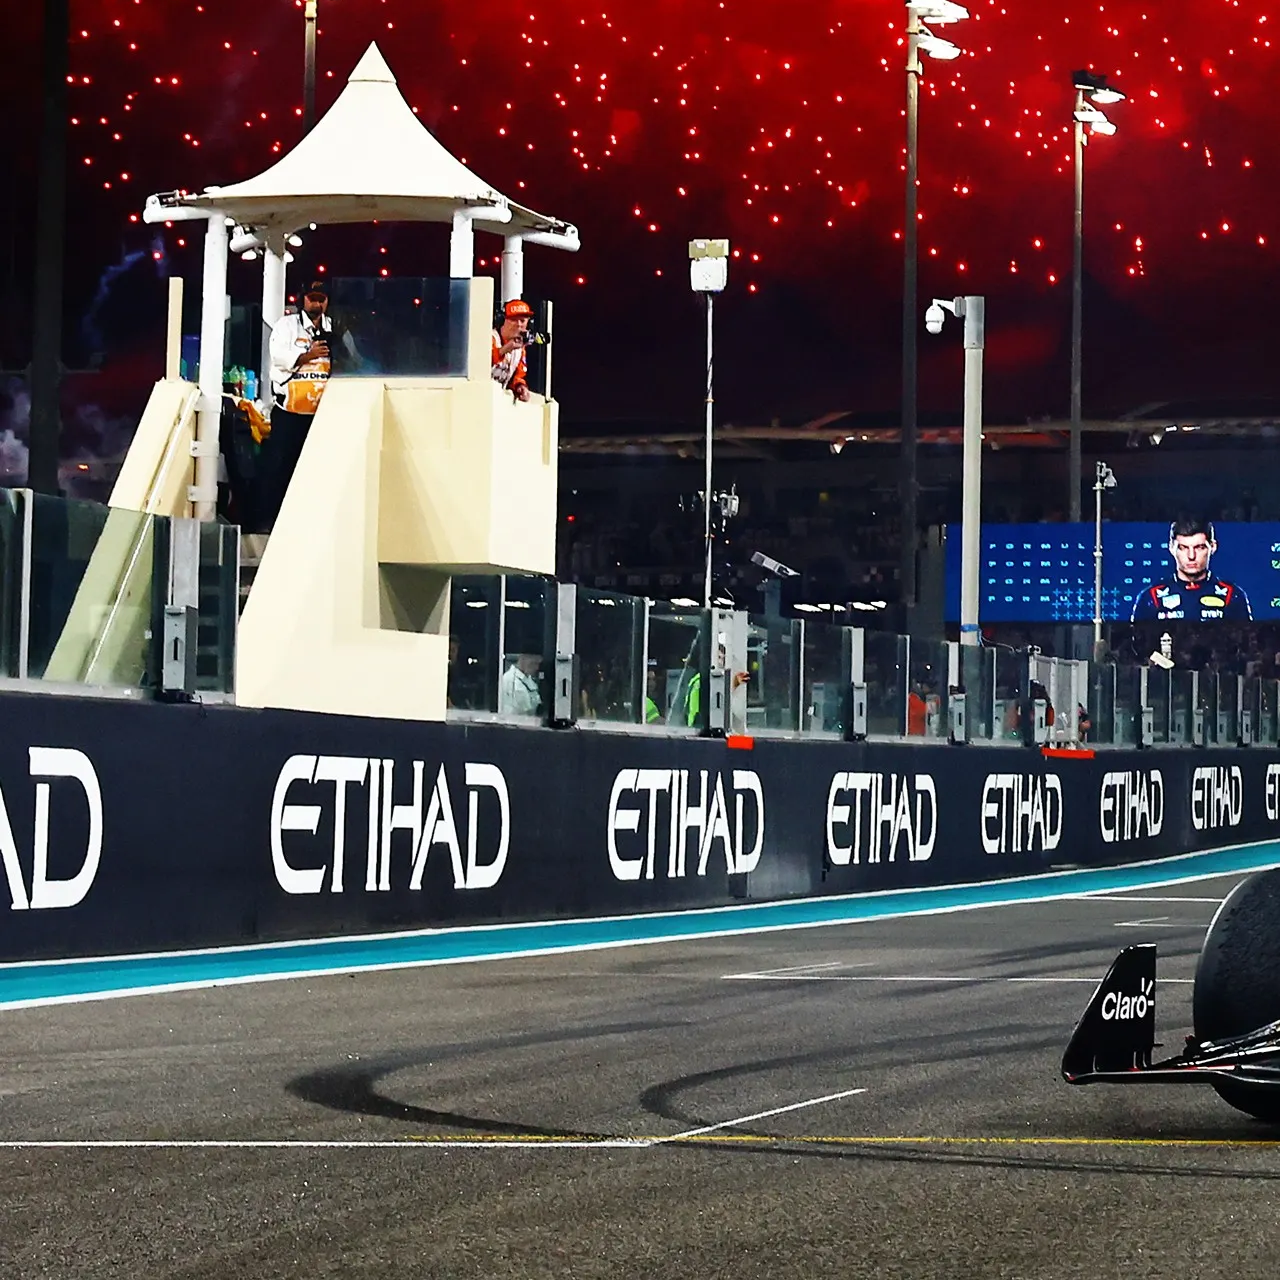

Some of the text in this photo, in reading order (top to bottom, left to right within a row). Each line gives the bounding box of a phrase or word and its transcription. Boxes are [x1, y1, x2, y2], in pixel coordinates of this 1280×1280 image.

[271, 754, 510, 894] ETIHAD
[607, 768, 765, 881] ETIHAD
[827, 772, 937, 865] ETIHAD
[981, 773, 1063, 854] ETIHAD
[1101, 769, 1163, 843] ETIHAD
[1192, 765, 1243, 829] ETIHAD
[1101, 988, 1149, 1021] Claro
